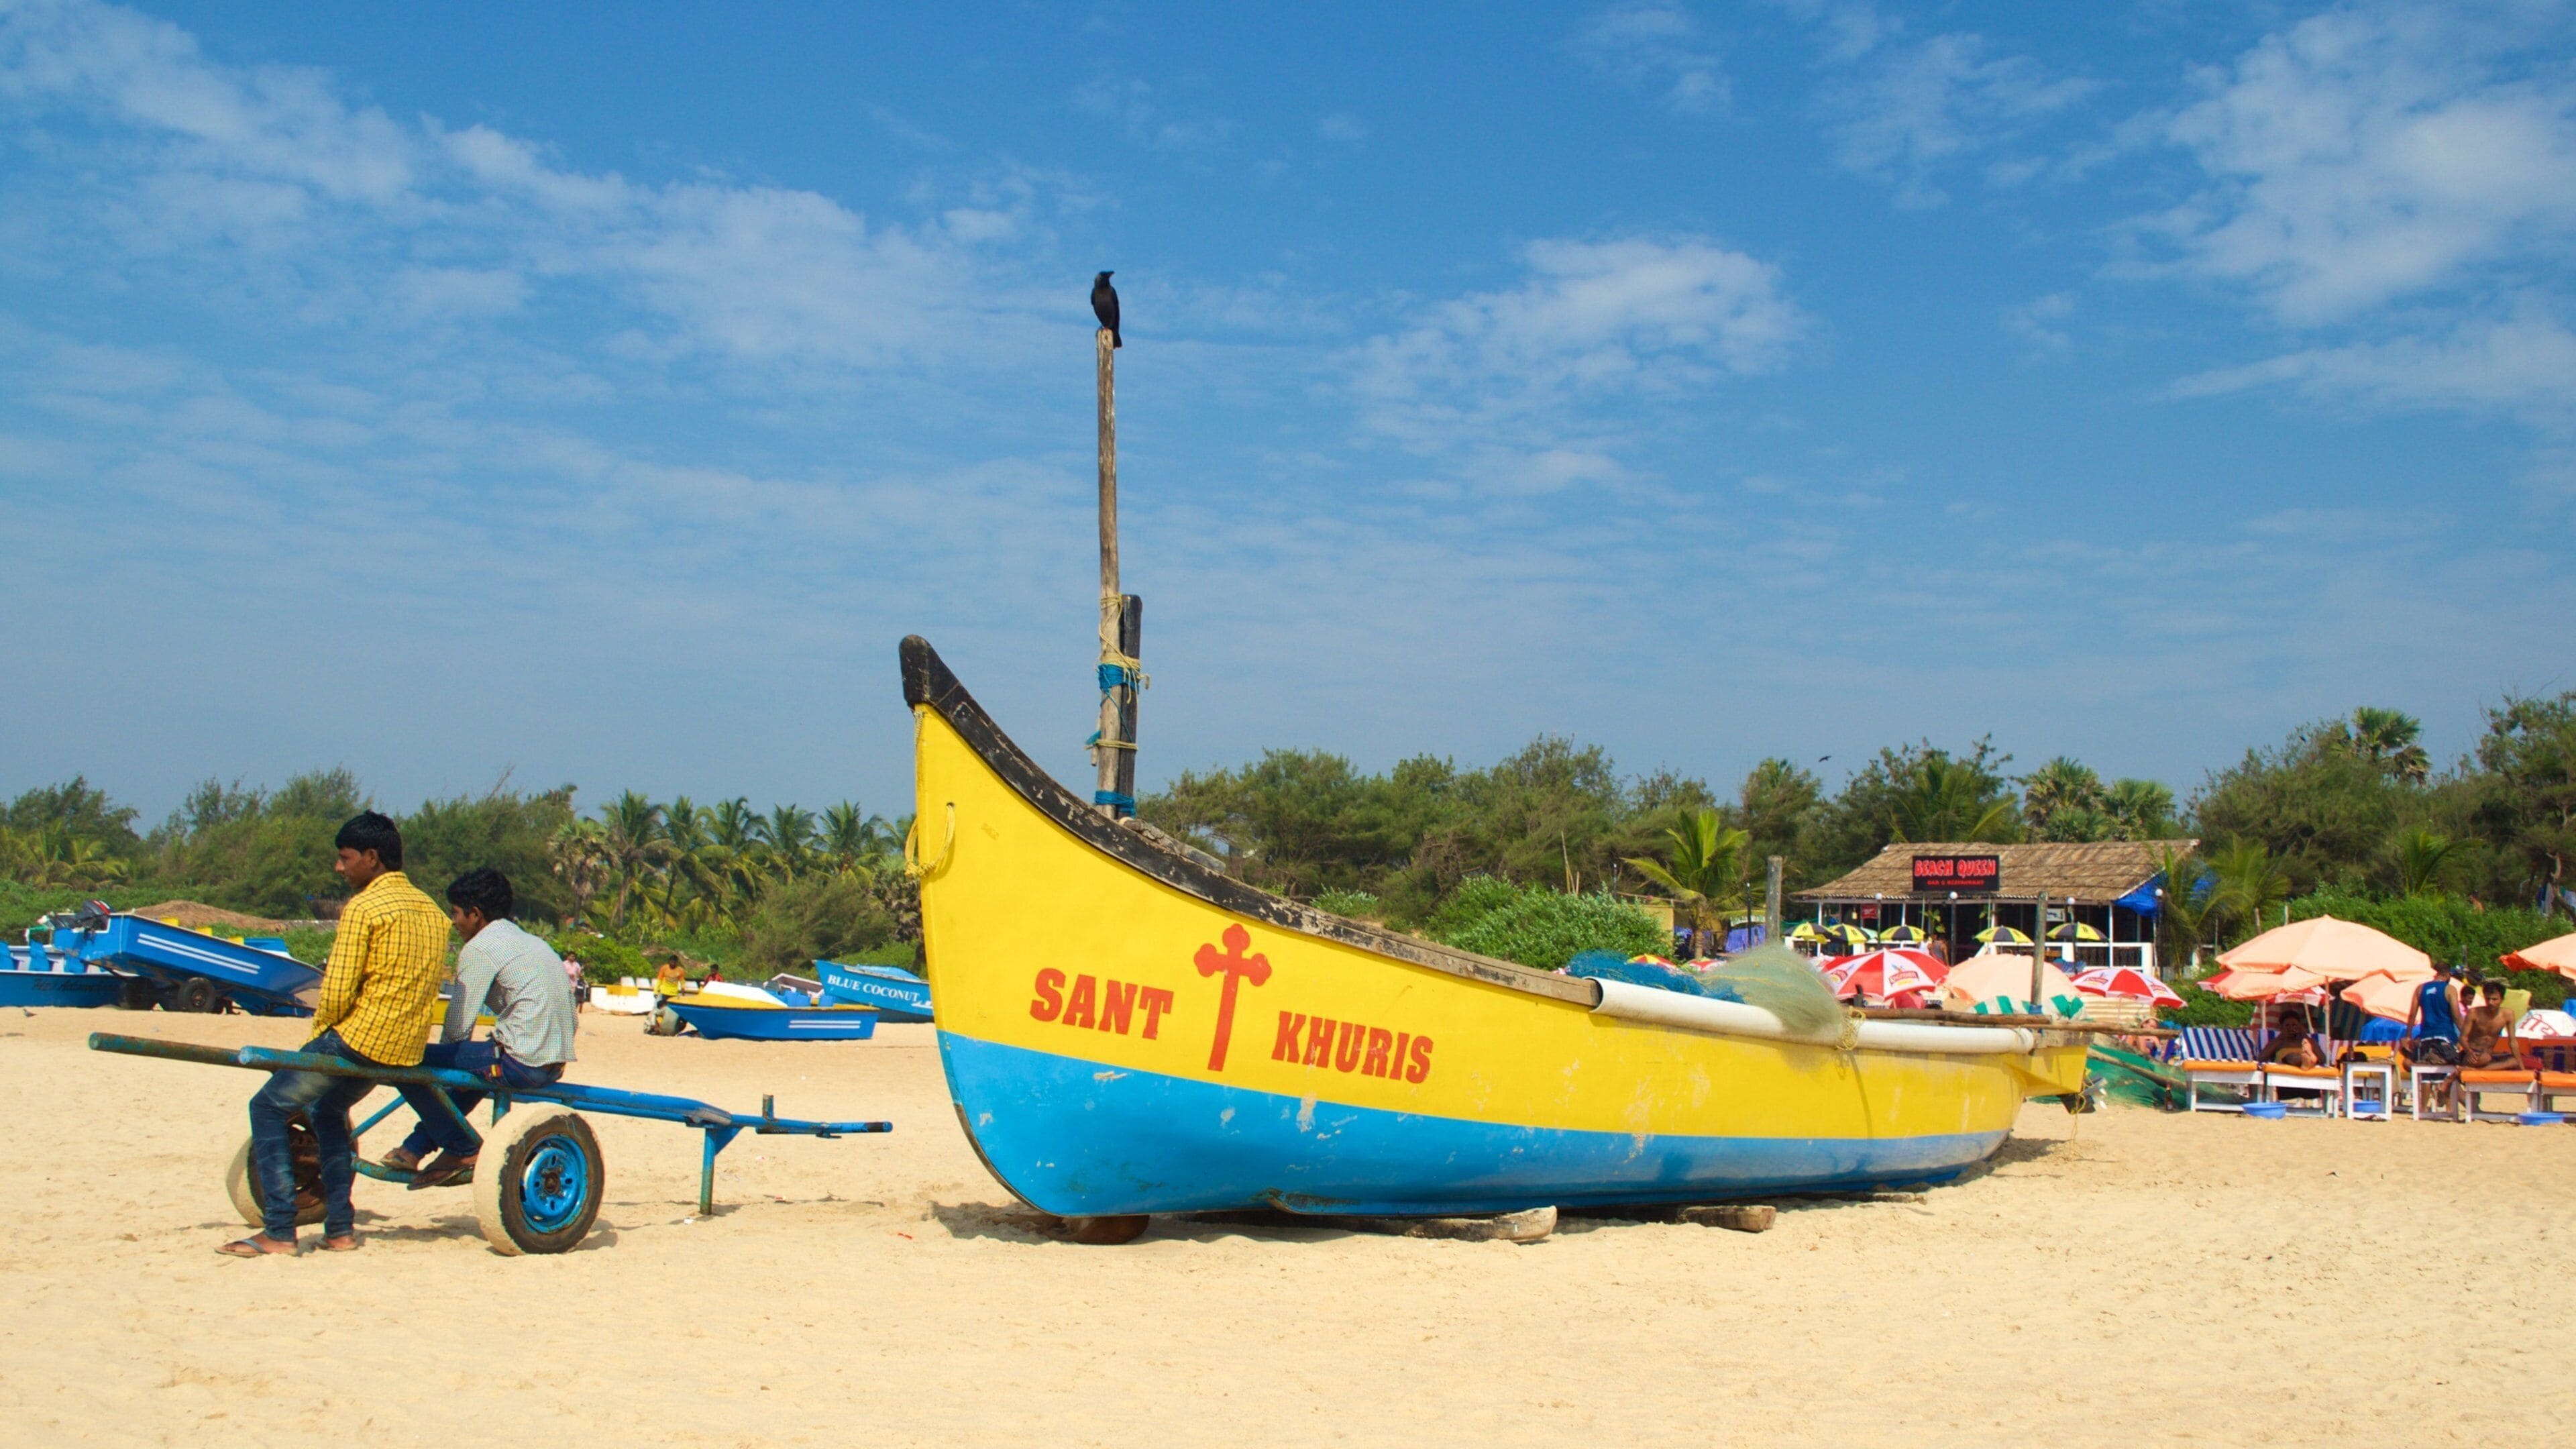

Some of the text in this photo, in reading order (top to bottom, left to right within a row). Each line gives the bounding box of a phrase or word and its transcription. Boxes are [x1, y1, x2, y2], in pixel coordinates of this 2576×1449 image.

[1915, 859, 1996, 878] BEACH QUEEN
[827, 974, 920, 1002] BLUE COCONUT
[1030, 967, 1434, 1084] SANT KHURIS
